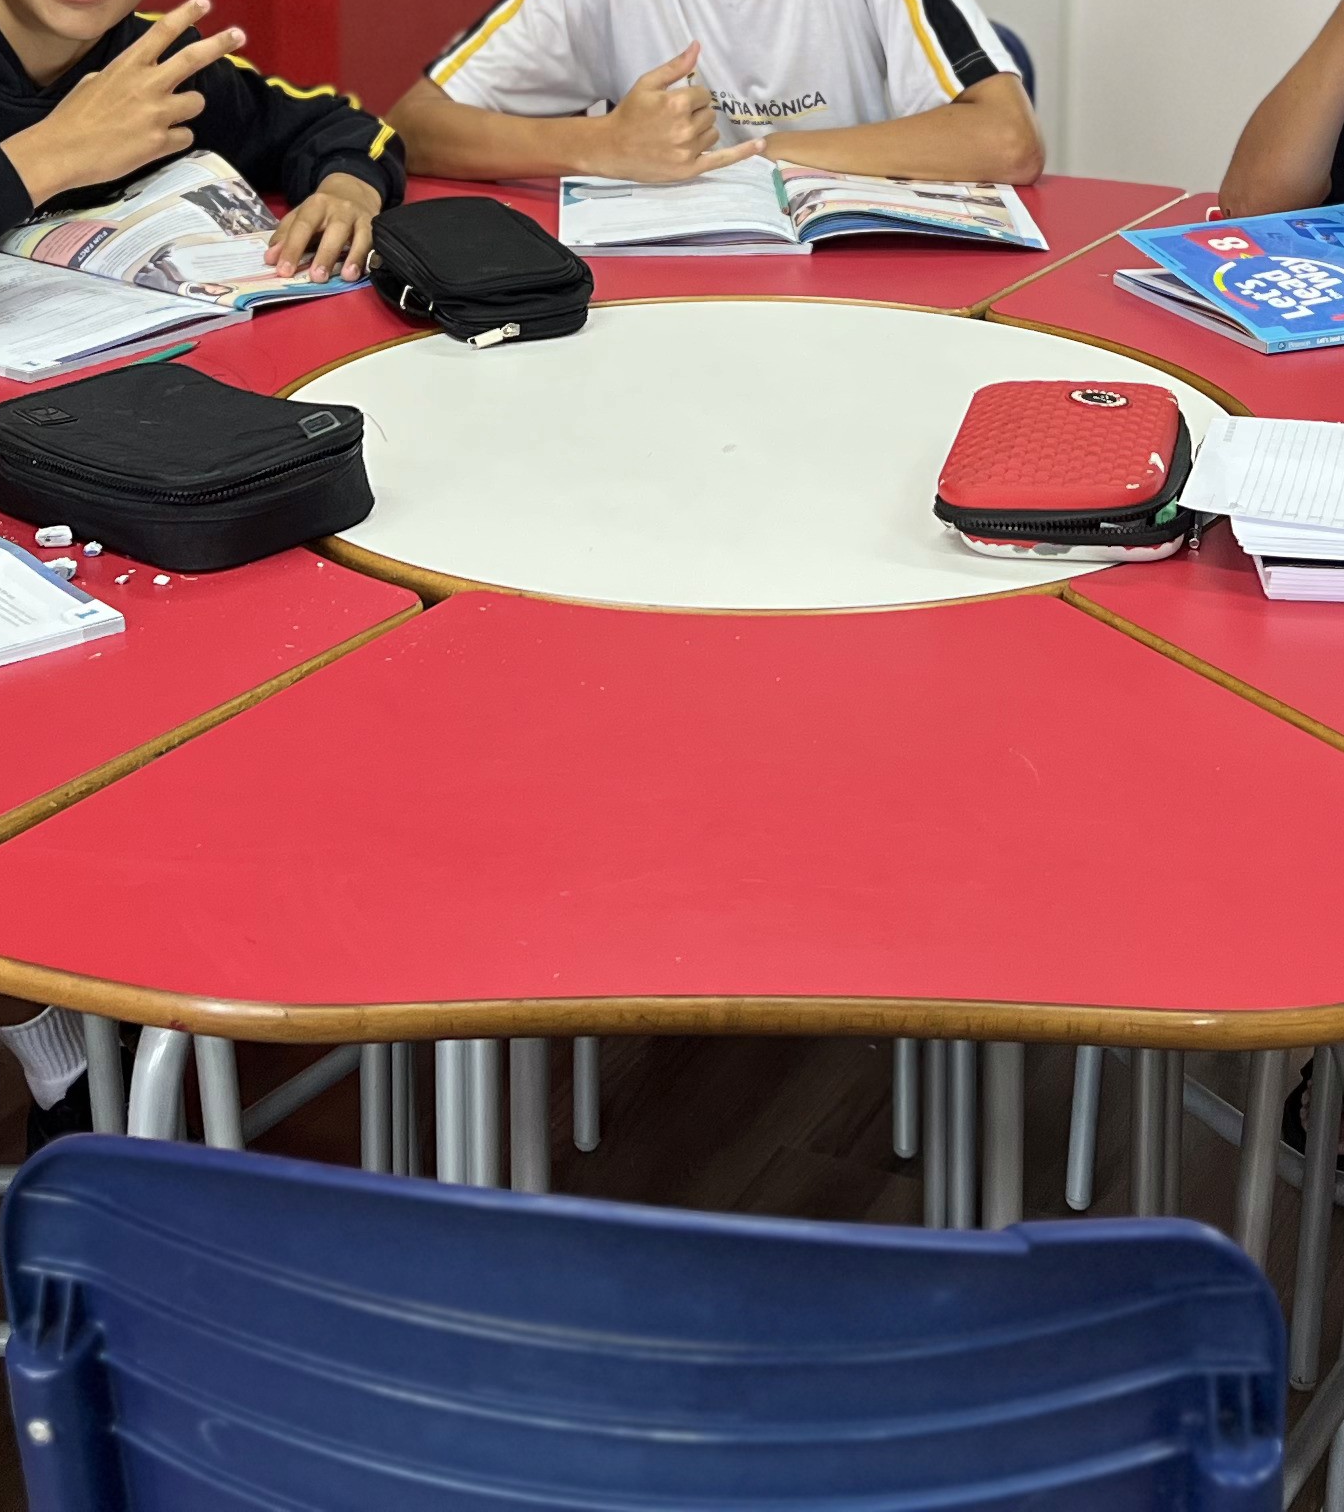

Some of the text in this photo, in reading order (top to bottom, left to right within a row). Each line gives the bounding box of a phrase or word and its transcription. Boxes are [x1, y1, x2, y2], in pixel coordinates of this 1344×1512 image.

[754, 91, 826, 117] MÔNICA
[1207, 236, 1250, 252] 8
[1234, 279, 1314, 319] Let's
